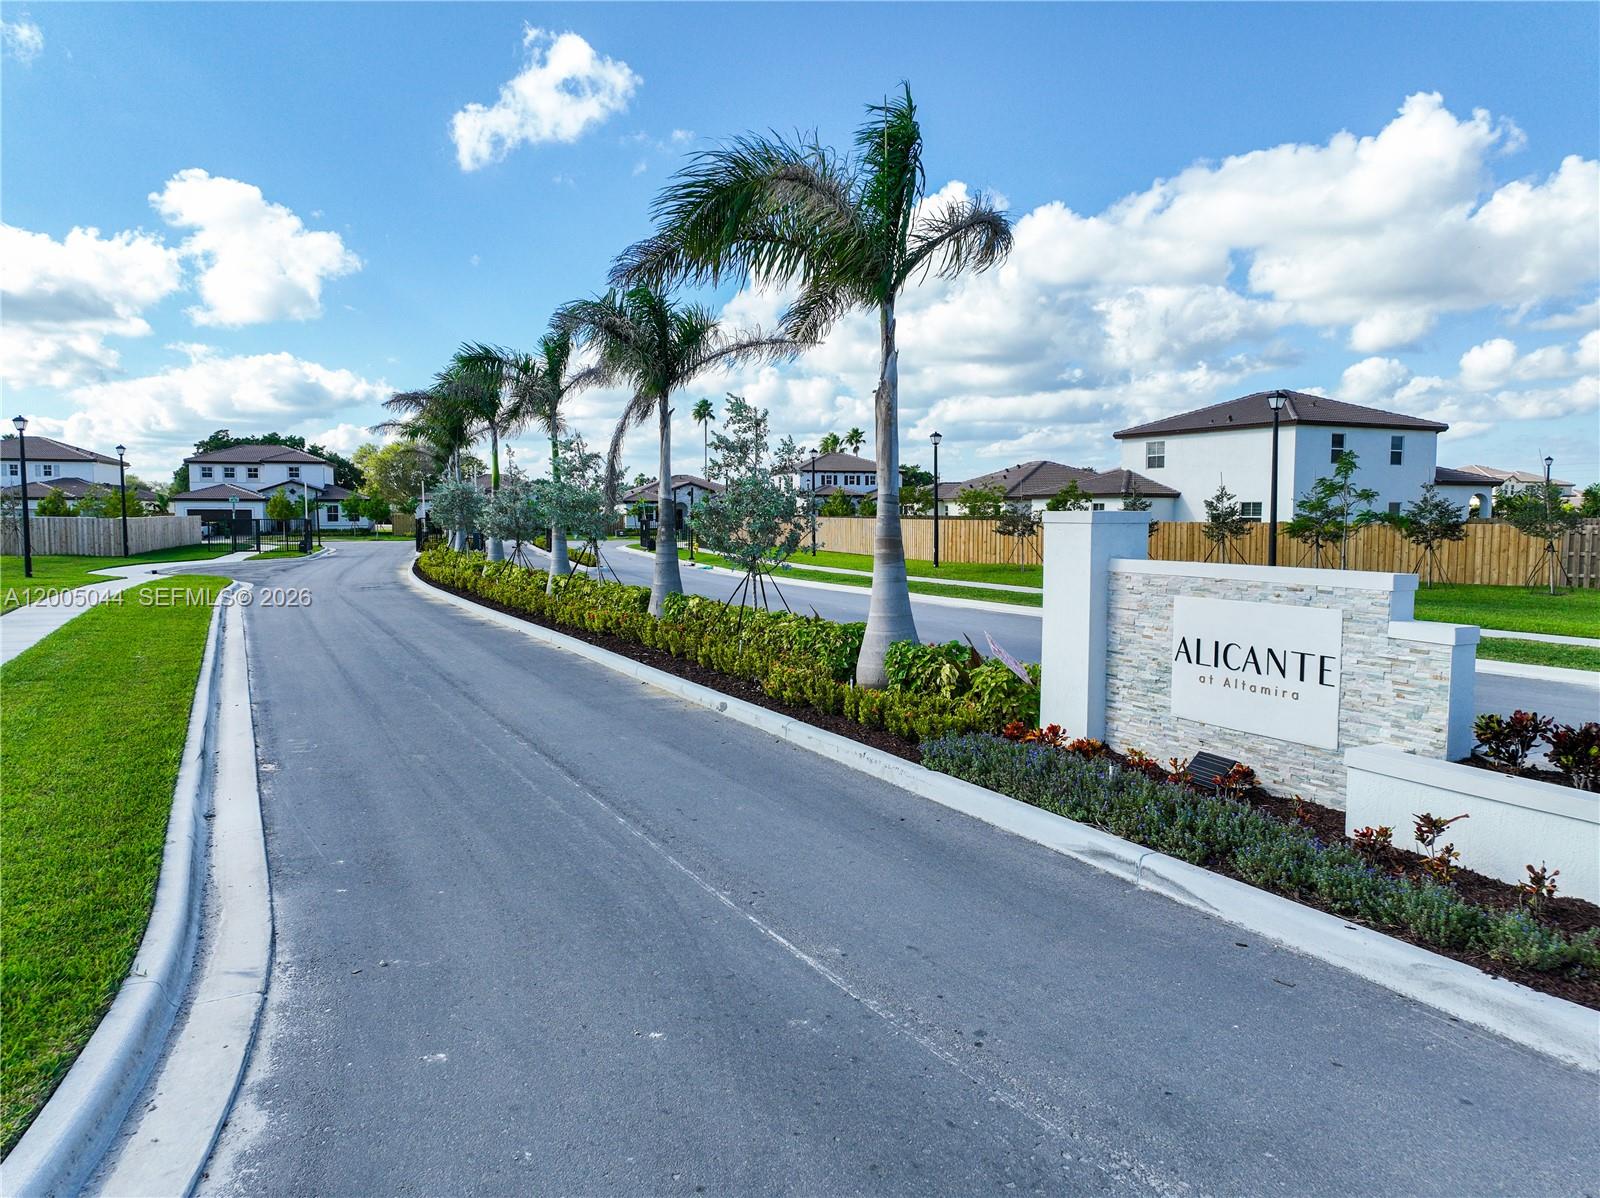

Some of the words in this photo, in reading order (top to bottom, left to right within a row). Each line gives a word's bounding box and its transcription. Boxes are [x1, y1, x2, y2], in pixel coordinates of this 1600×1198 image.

[1174, 636, 1337, 688] ALICANTE
[1198, 674, 1213, 685] at
[1223, 677, 1300, 701] Altamira
